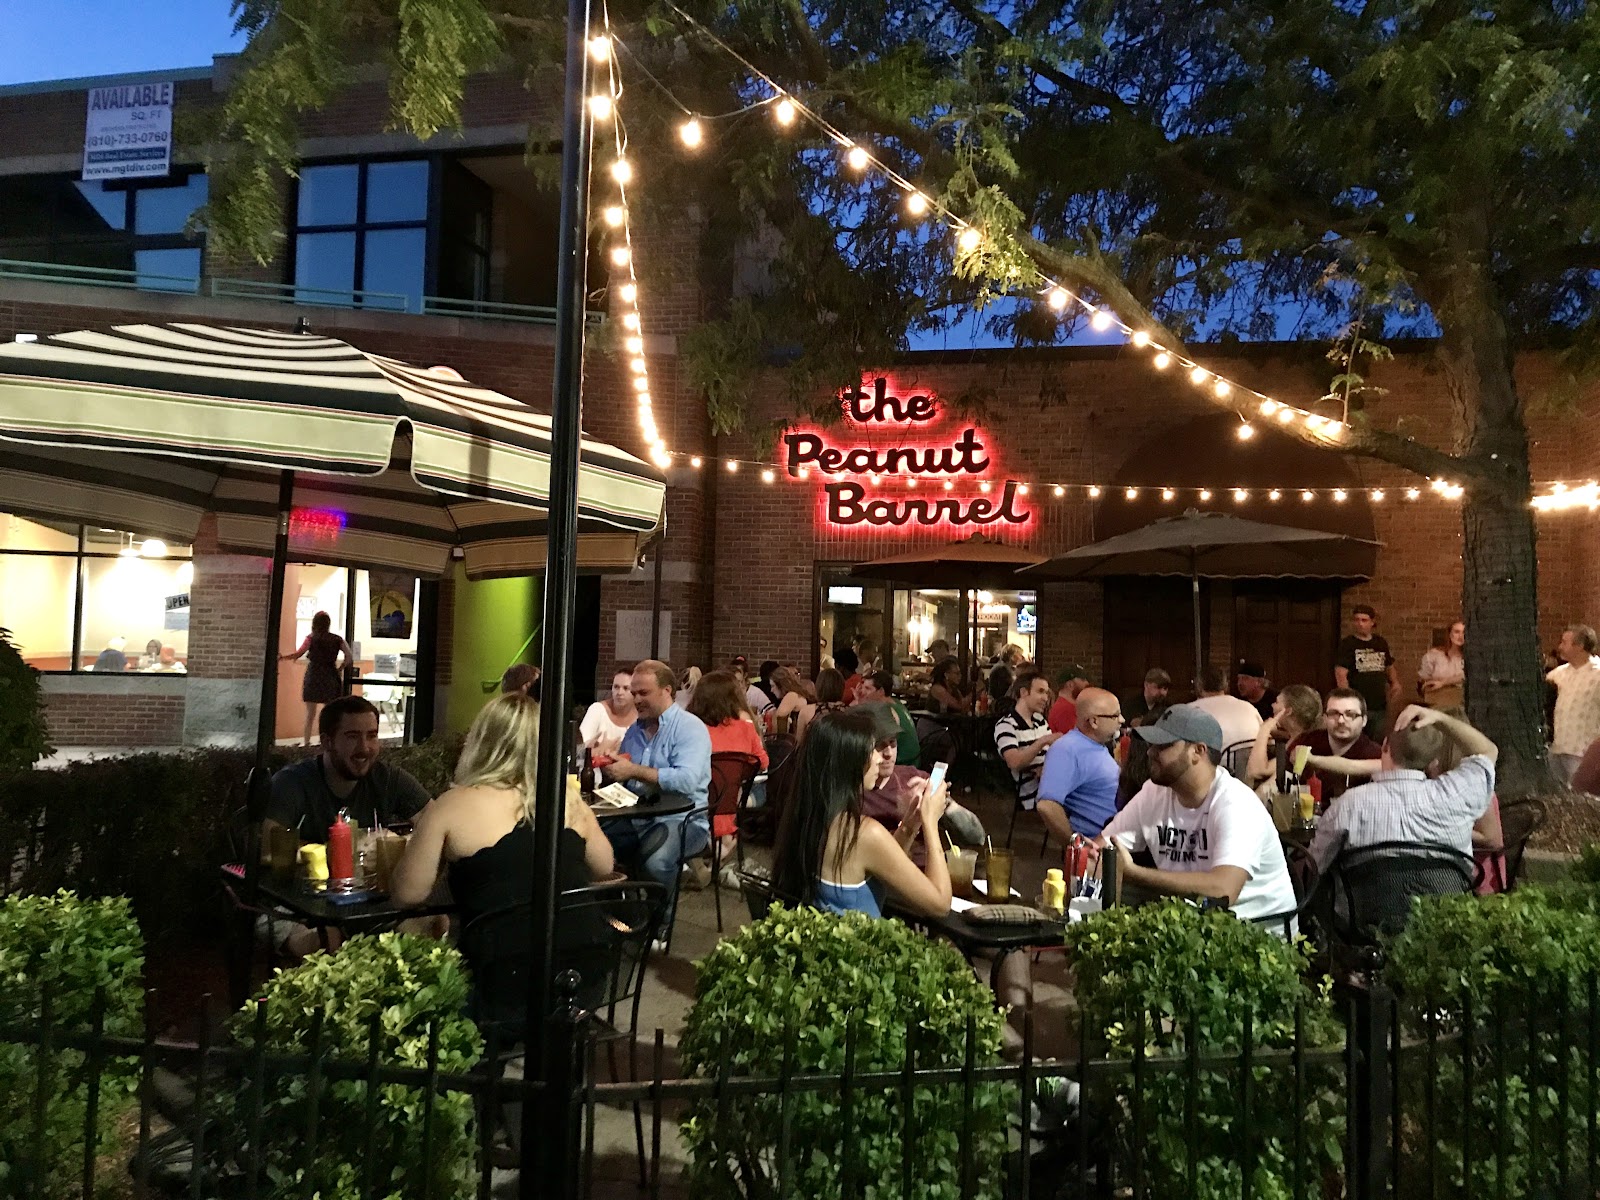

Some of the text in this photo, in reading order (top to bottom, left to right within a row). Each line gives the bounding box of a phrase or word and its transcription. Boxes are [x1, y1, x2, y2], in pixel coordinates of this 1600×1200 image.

[91, 84, 170, 110] AVAILABLE
[843, 378, 935, 422] the
[784, 429, 990, 478] Peanut
[824, 480, 1030, 526] Barrel
